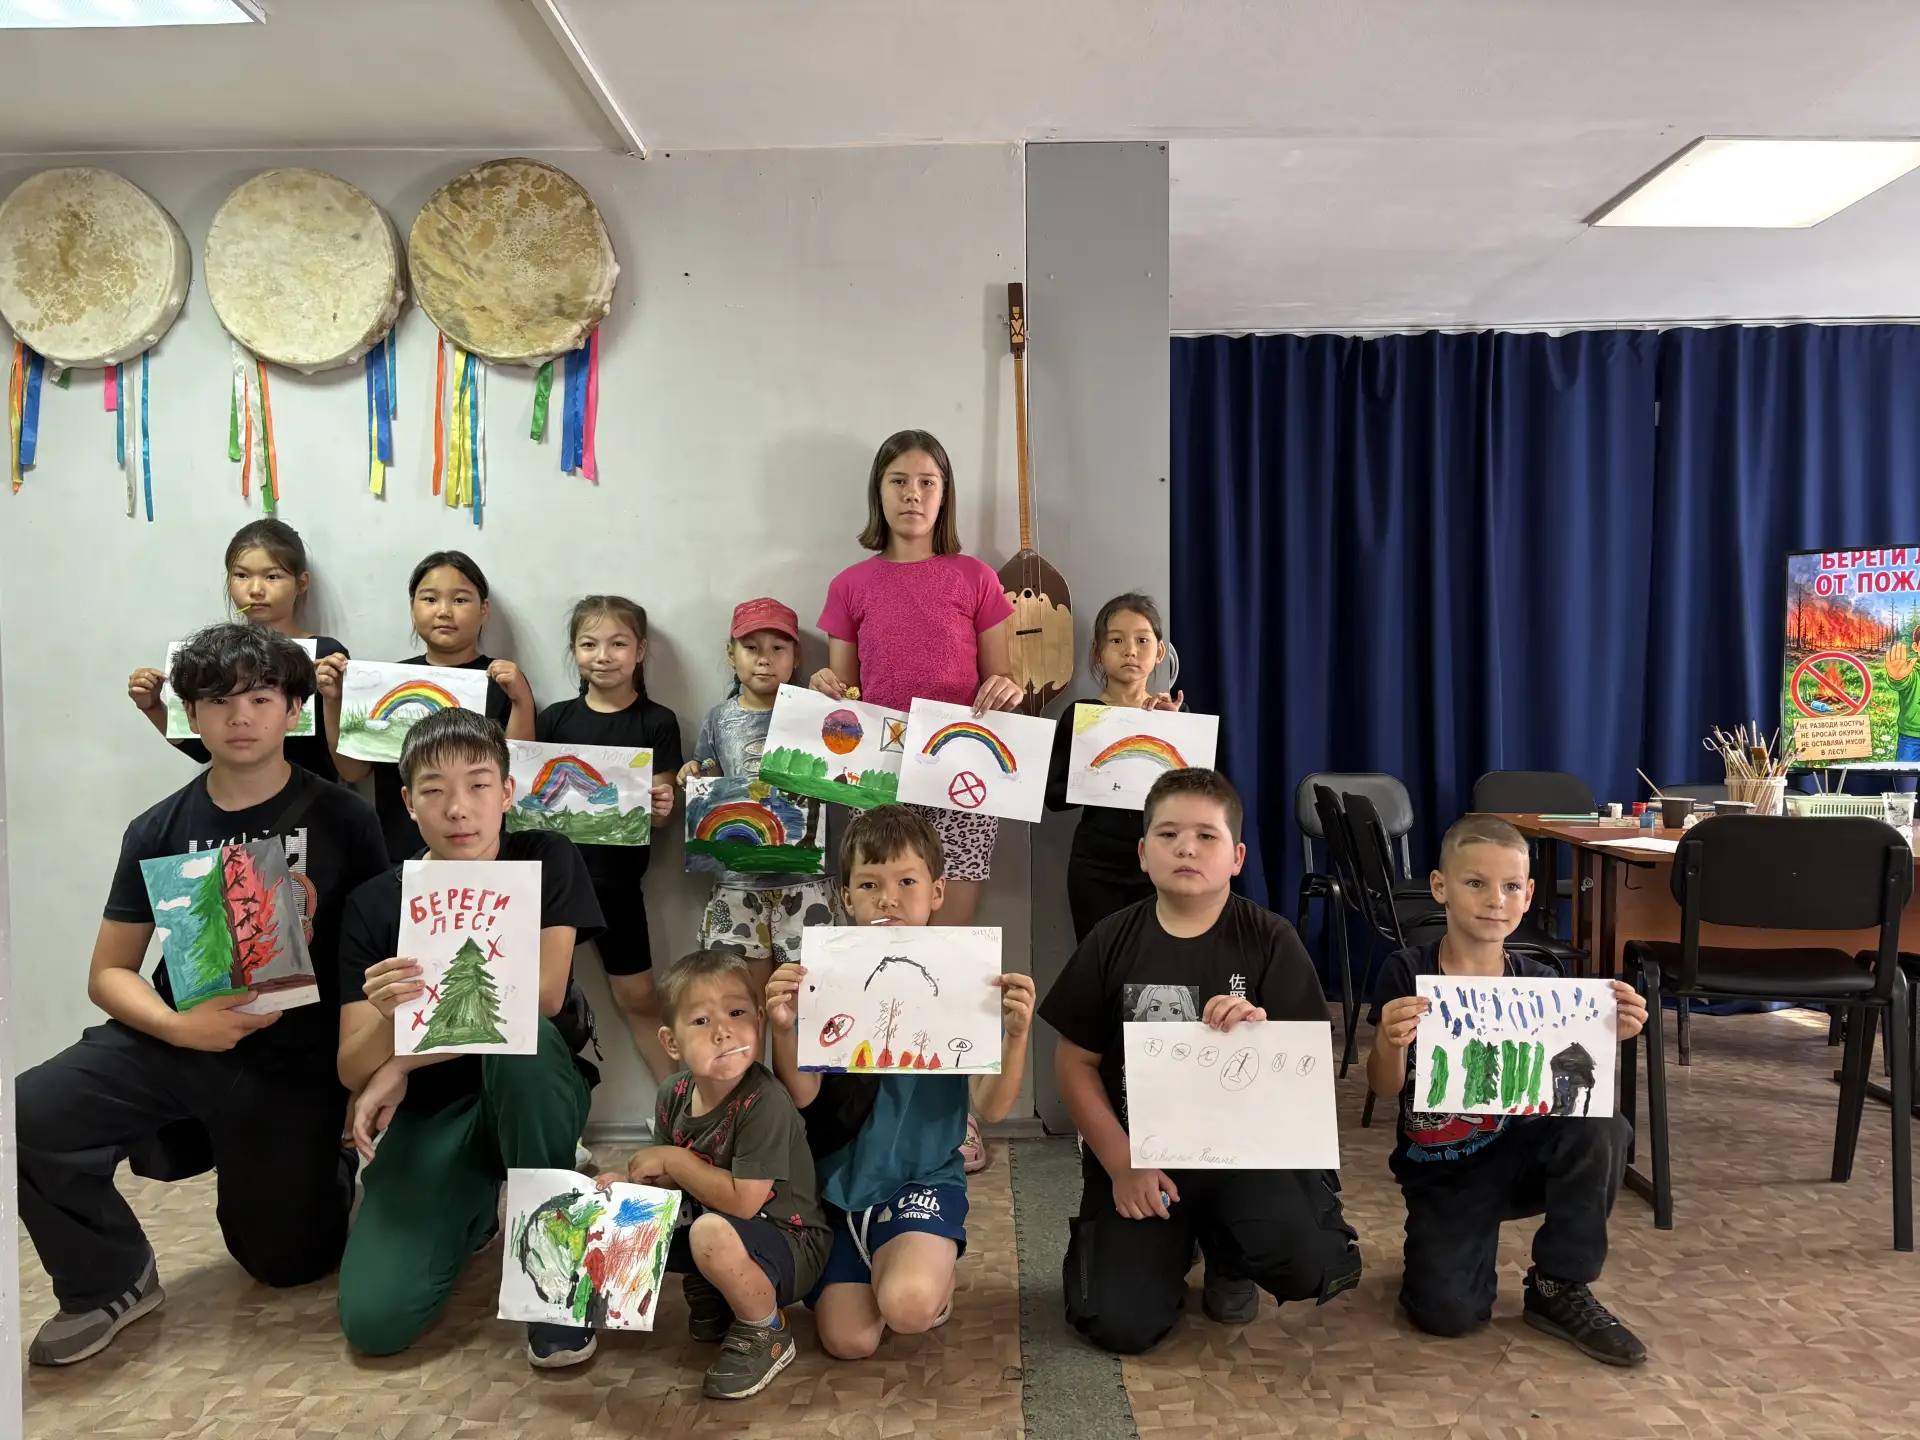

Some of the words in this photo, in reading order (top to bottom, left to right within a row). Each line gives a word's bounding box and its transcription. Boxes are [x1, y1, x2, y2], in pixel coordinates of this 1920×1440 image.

[1822, 548, 1906, 569] БЕРЕГИ
[1816, 573, 1848, 595] ОТ
[1857, 571, 1920, 593] ПОЖ
[1810, 721, 1838, 729] РАЗВОДИ
[1812, 730, 1837, 738] БРОСАЙ
[1812, 739, 1844, 747] ОСТАВЛЯЙ
[1828, 748, 1847, 756] ЛЕСУ!
[409, 888, 511, 924] БЕРЕГИ
[430, 912, 496, 936] ЛЕС!
